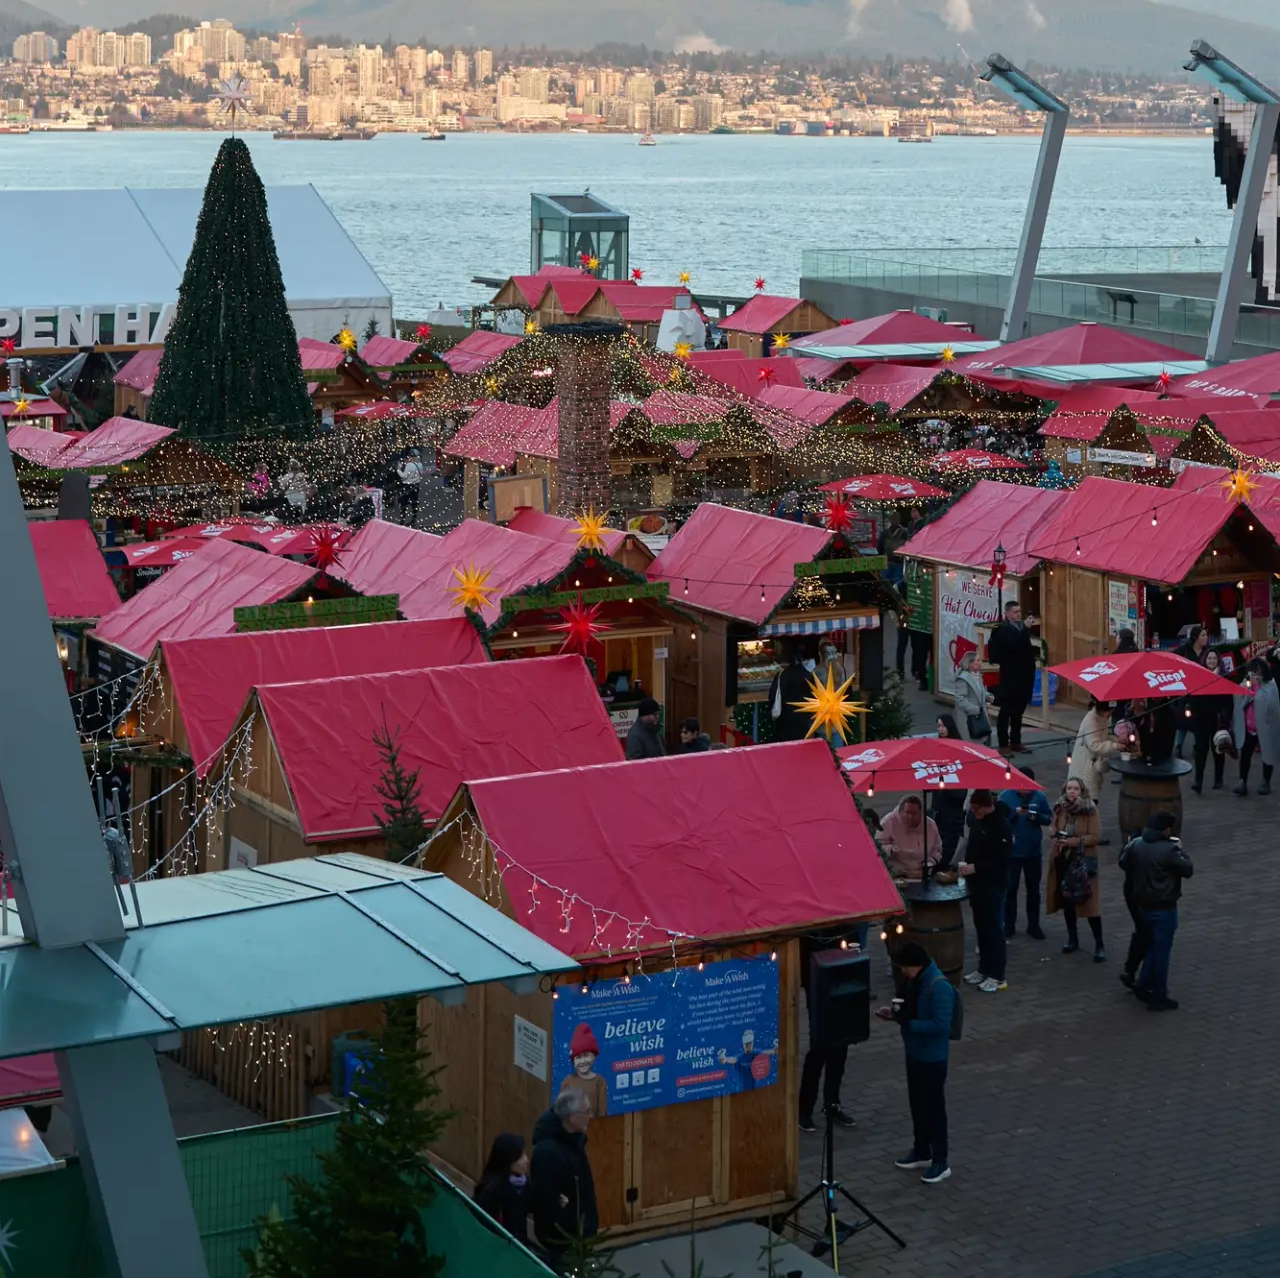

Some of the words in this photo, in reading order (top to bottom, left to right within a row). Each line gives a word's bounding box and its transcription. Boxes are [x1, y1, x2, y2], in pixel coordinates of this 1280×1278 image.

[1184, 379, 1209, 388] TAP
[961, 581, 972, 593] WE
[973, 583, 993, 598] SERVE
[235, 603, 308, 621] BARISTA
[313, 595, 398, 617] BROTHERS
[941, 595, 963, 615] Hot
[1143, 669, 1187, 688] Stiegl
[613, 720, 634, 728] ORDER
[604, 1018, 666, 1039] believe
[629, 1034, 665, 1053] wish
[676, 1045, 715, 1061] believe
[632, 1058, 653, 1067] DONATE
[692, 1057, 714, 1070] wish
